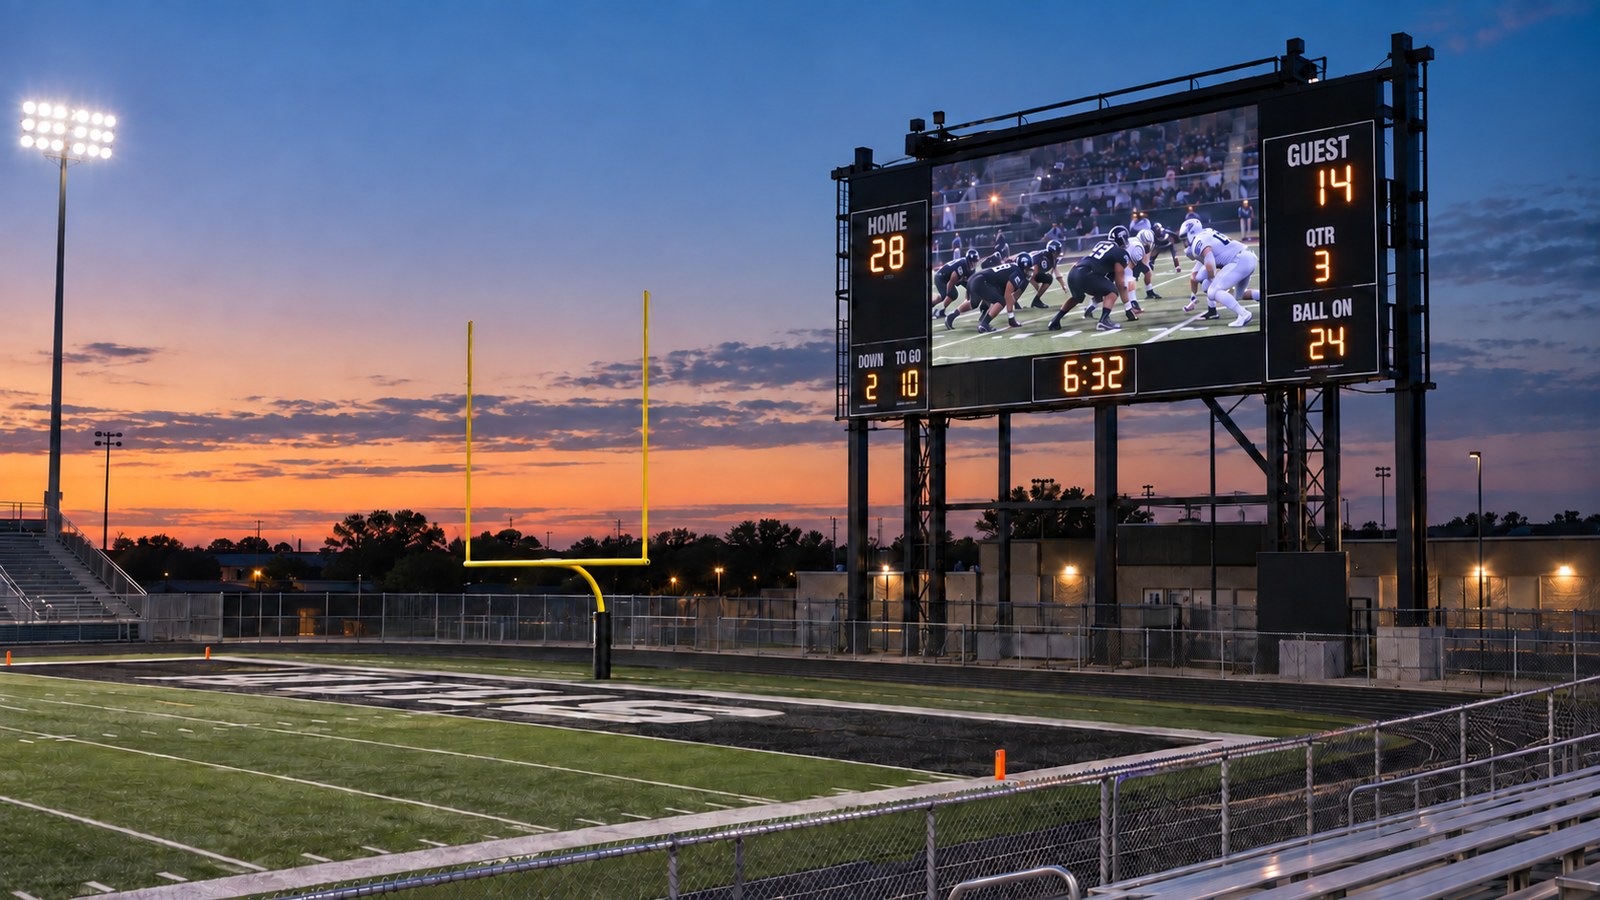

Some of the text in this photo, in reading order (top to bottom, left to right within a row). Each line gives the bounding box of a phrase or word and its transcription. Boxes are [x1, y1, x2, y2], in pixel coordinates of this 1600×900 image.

[1287, 134, 1350, 167] GUEST
[1320, 164, 1351, 206] 14
[868, 210, 907, 236] HOME
[1306, 226, 1335, 248] QTR
[870, 235, 904, 273] 28
[1315, 250, 1330, 282] 3
[1292, 298, 1352, 322] BALL ON
[895, 348, 921, 365] TO GO
[1310, 326, 1345, 360] 24
[858, 352, 884, 369] DOWN
[1064, 355, 1123, 392] 6:32
[866, 373, 877, 400] 2
[902, 369, 918, 397] 10
